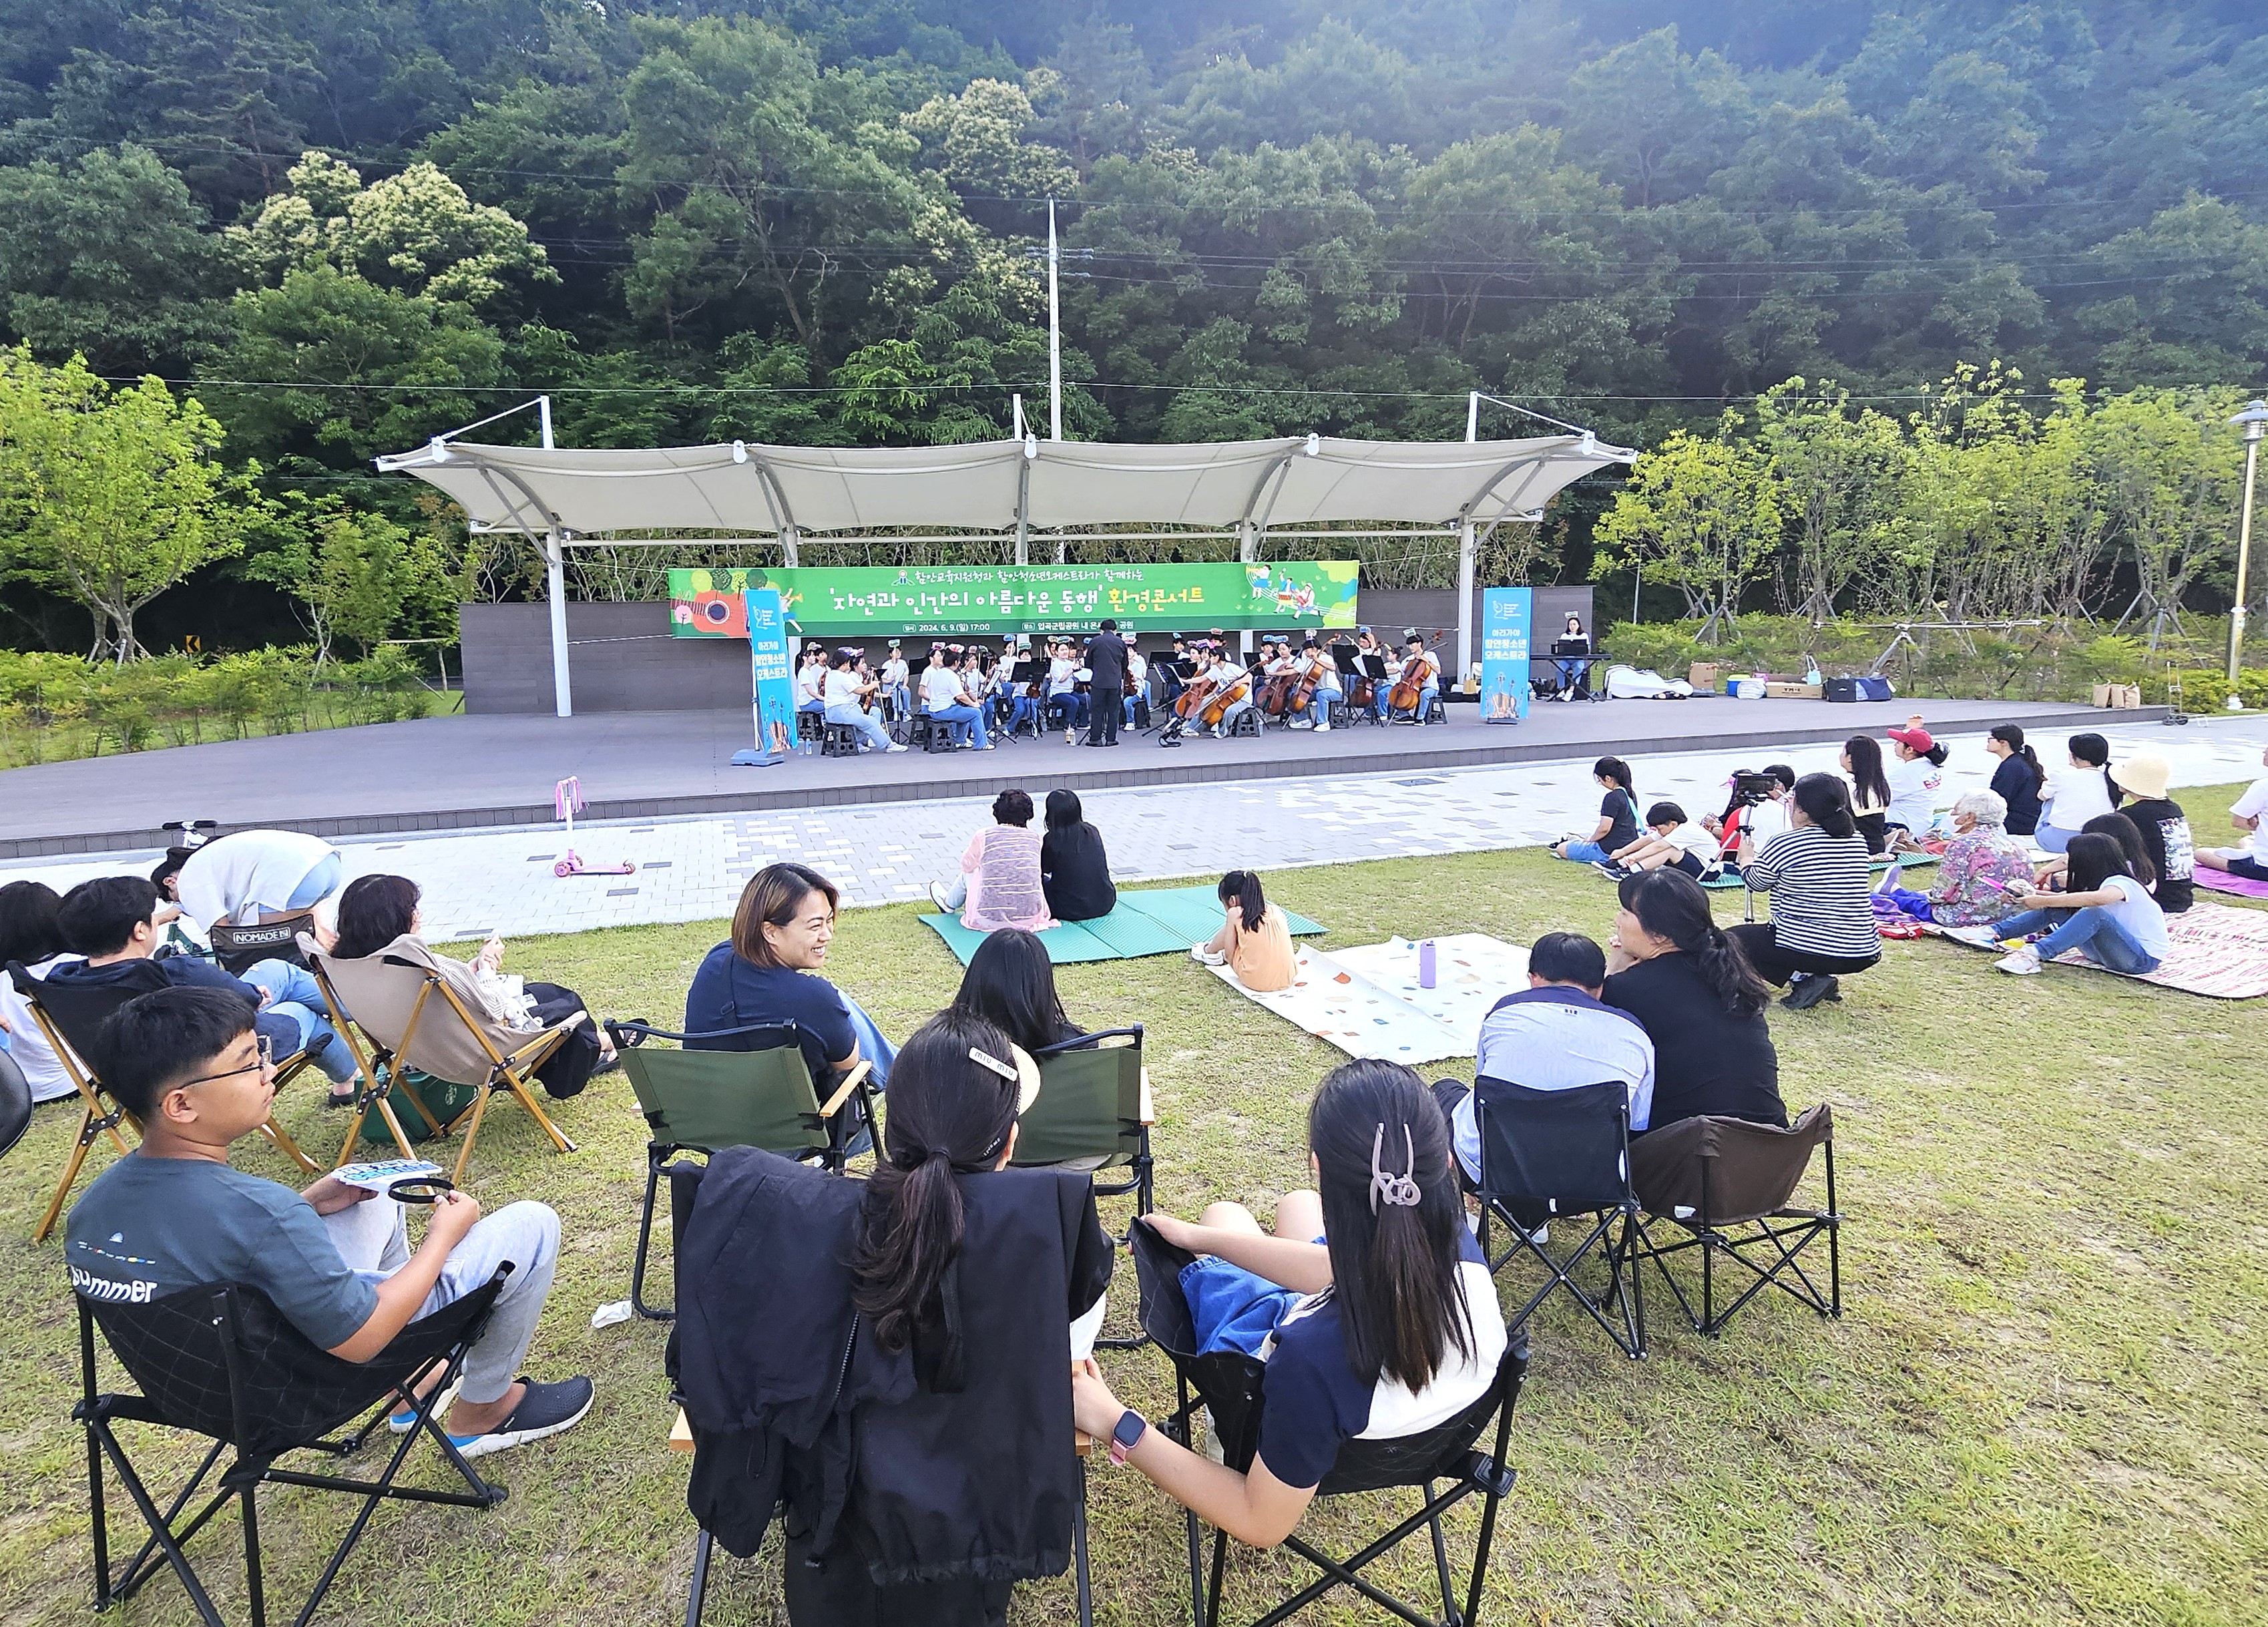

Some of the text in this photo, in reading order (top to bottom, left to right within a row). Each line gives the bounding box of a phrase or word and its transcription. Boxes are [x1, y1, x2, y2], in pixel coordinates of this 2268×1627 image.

[915, 568, 1144, 585] 함안교육지원청과 함안청소년오케스트라가 함께하는
[905, 592, 968, 615] 인간의
[976, 590, 1053, 614] 아름다운
[1108, 587, 1205, 613] 환경콘서트
[941, 624, 948, 632] 6.
[970, 623, 990, 631] 17:00
[1038, 622, 1079, 631] 입곡군립공원
[1081, 622, 1088, 630] 내
[1119, 621, 1134, 630] 공원
[236, 929, 288, 942] NOMADEN
